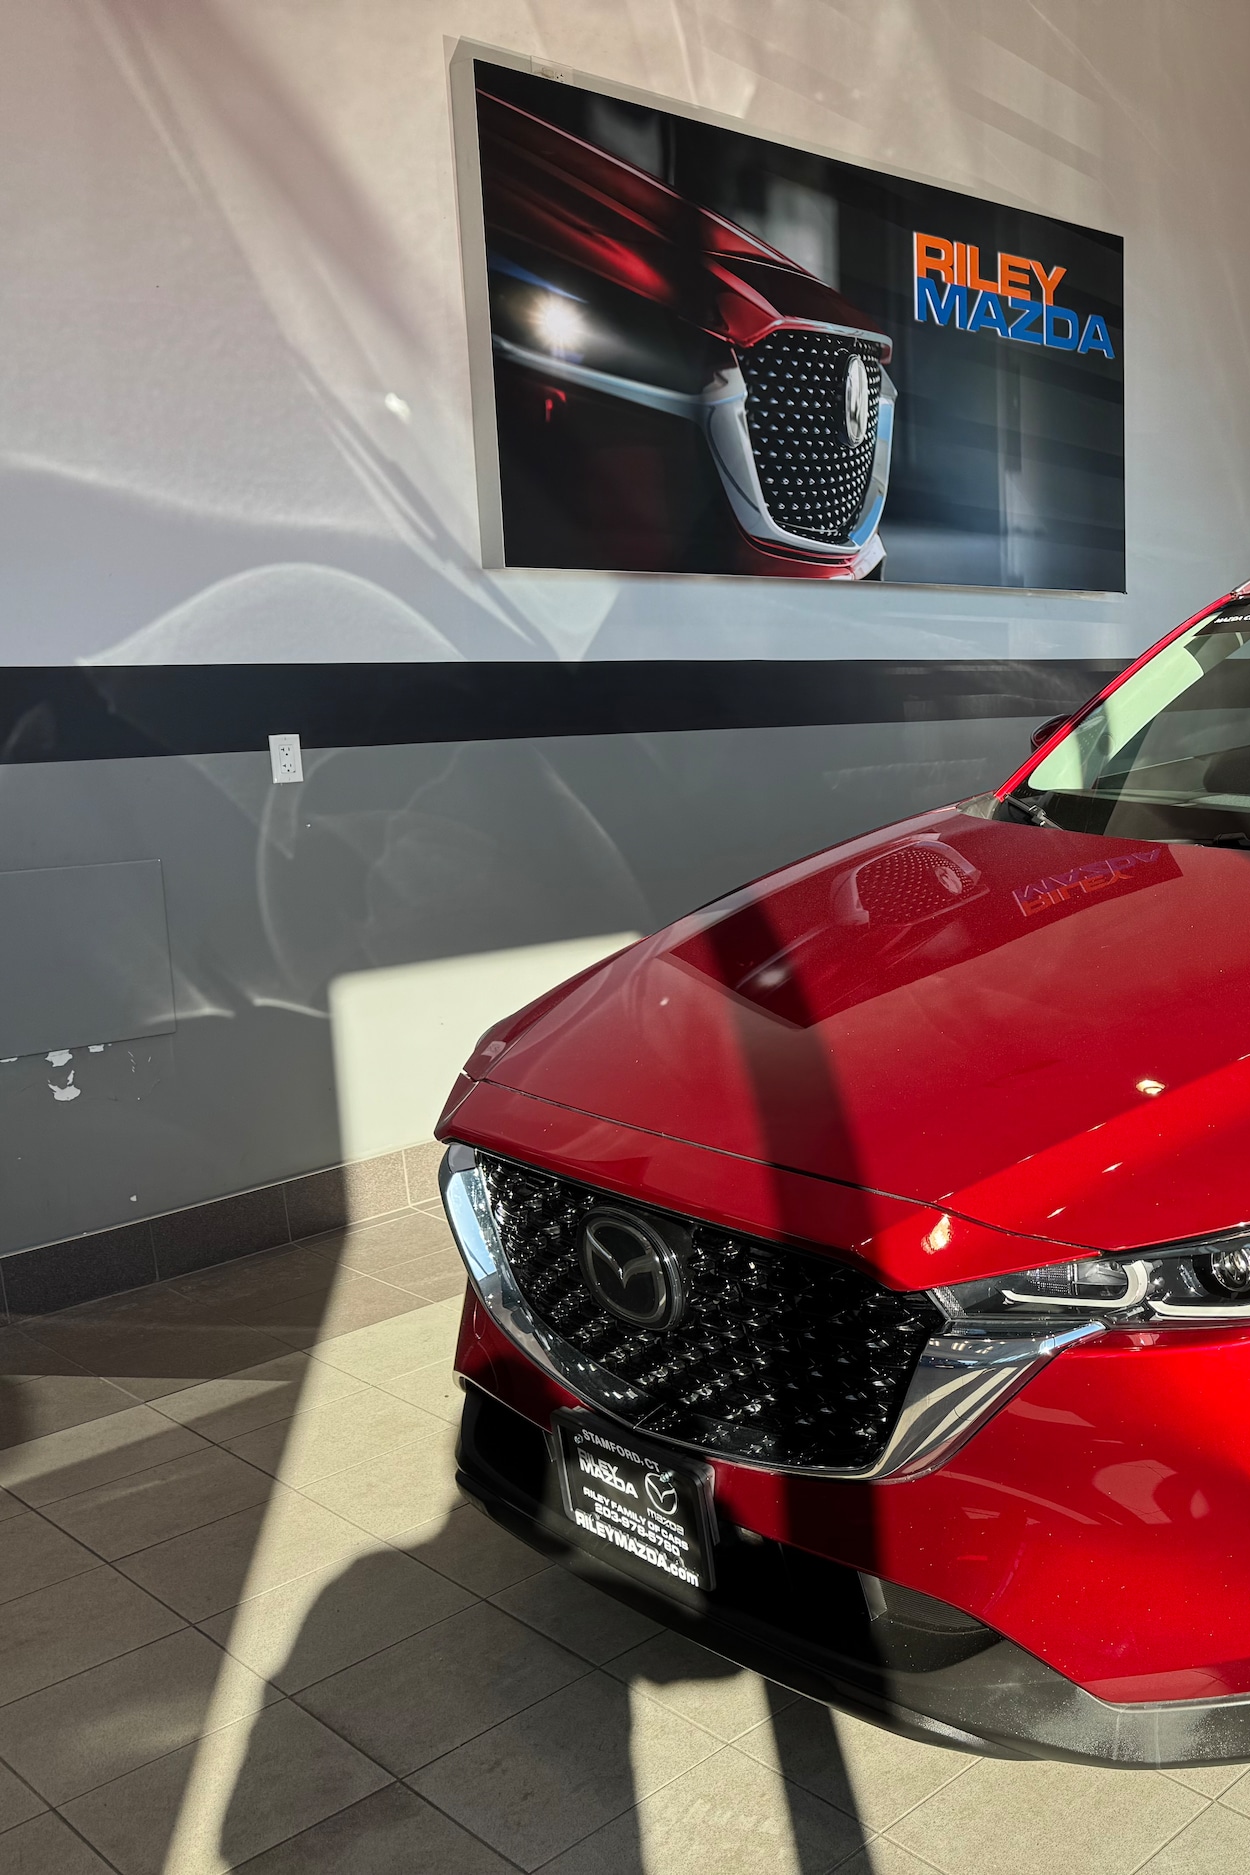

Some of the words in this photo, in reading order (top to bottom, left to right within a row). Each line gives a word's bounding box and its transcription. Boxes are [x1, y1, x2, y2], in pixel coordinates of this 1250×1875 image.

[913, 231, 1067, 306] RILEY
[914, 276, 1115, 359] MAZDA
[577, 1447, 619, 1477] RILEY
[579, 1457, 639, 1499] MAZDA
[644, 1457, 661, 1473] CT
[583, 1486, 610, 1507] RILEY
[611, 1499, 647, 1525] FAMILY
[648, 1519, 662, 1534] OF
[660, 1526, 689, 1551] CARS
[646, 1507, 685, 1536] mazda
[574, 1508, 700, 1588] RILEYMAZDA.com
